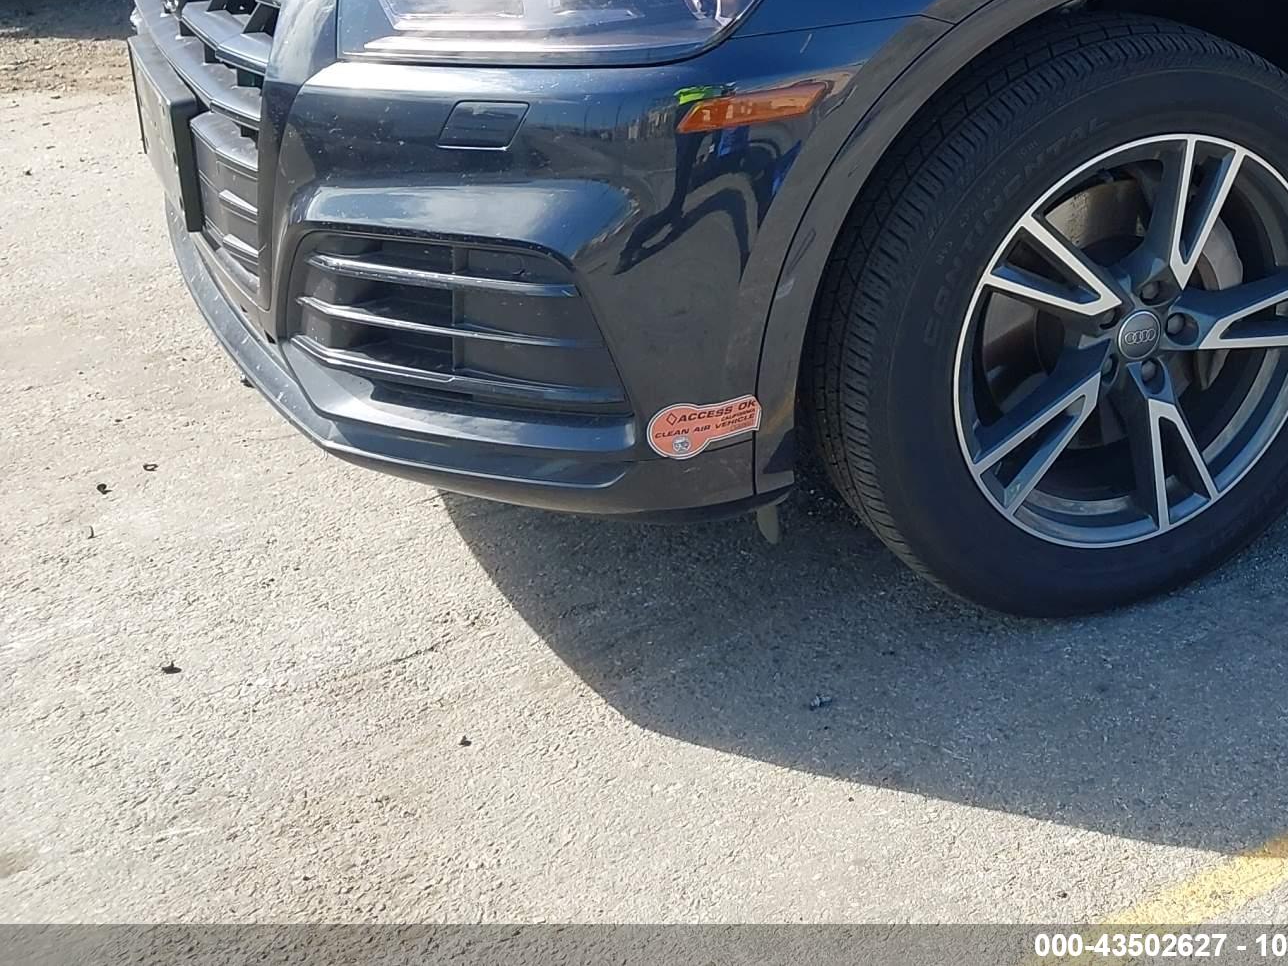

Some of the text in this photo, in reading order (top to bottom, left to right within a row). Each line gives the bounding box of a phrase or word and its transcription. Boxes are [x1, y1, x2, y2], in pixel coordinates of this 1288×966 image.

[677, 399, 756, 423] ACCESS OK
[654, 429, 690, 438] CLEAN
[693, 424, 711, 432] AIR
[715, 413, 755, 429] VEHICLE
